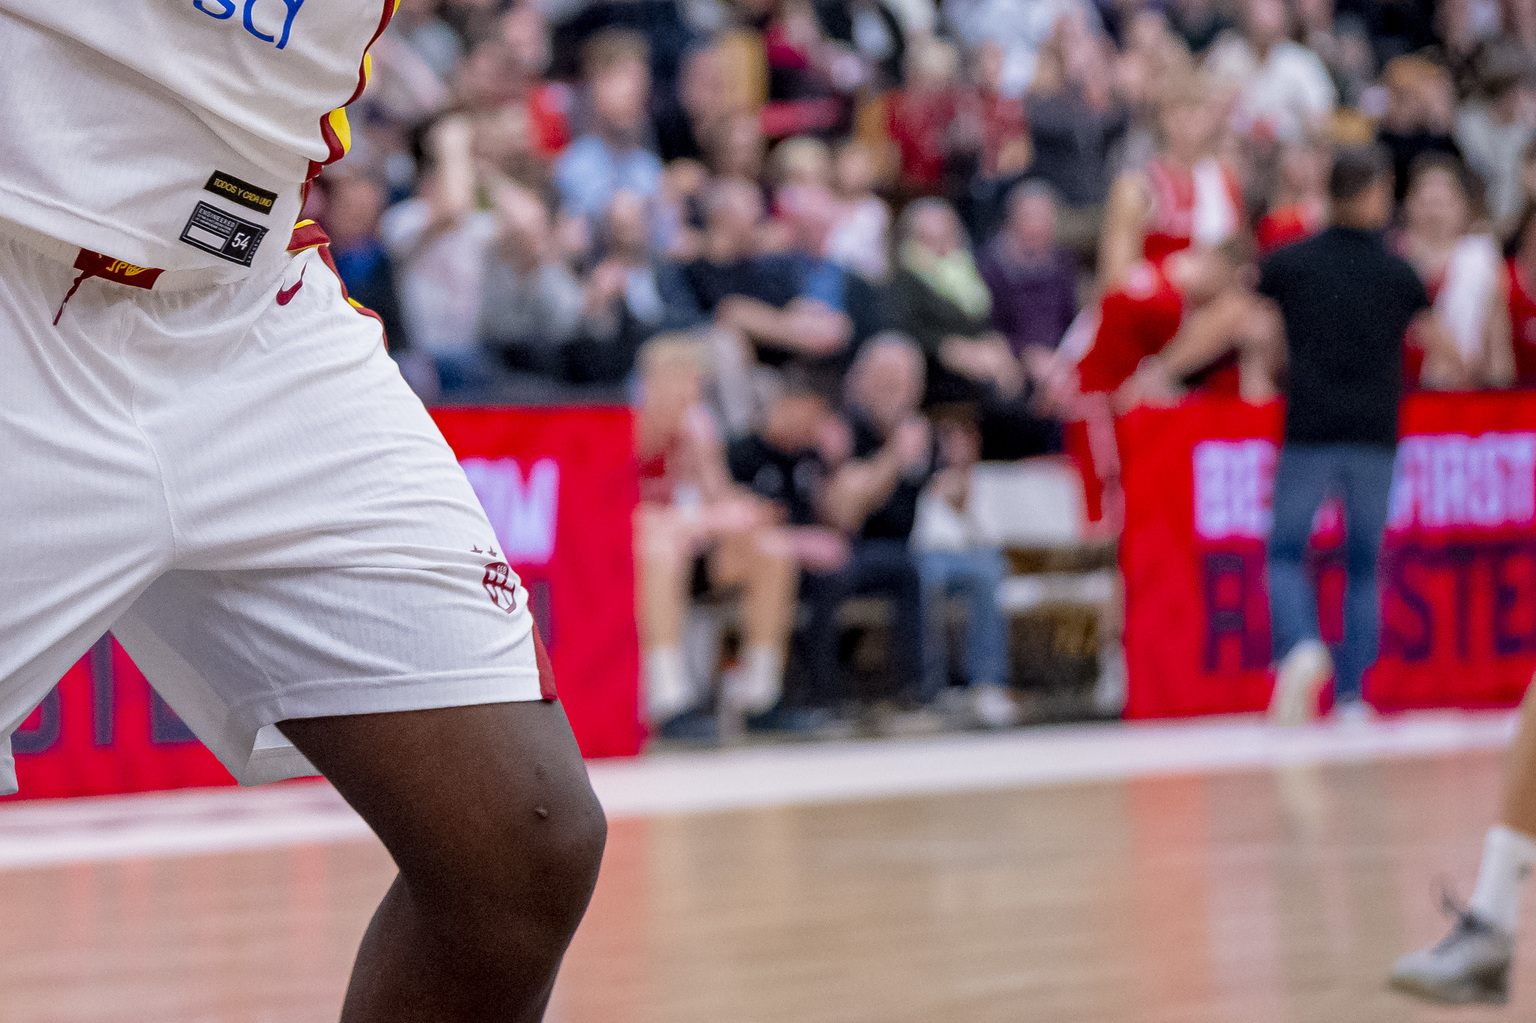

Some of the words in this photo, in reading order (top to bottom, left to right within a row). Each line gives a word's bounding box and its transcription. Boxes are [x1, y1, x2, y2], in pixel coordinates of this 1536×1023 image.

[213, 177, 238, 194] TODOS
[237, 187, 244, 196] Y
[242, 191, 259, 204] CADA
[231, 231, 252, 251] 54
